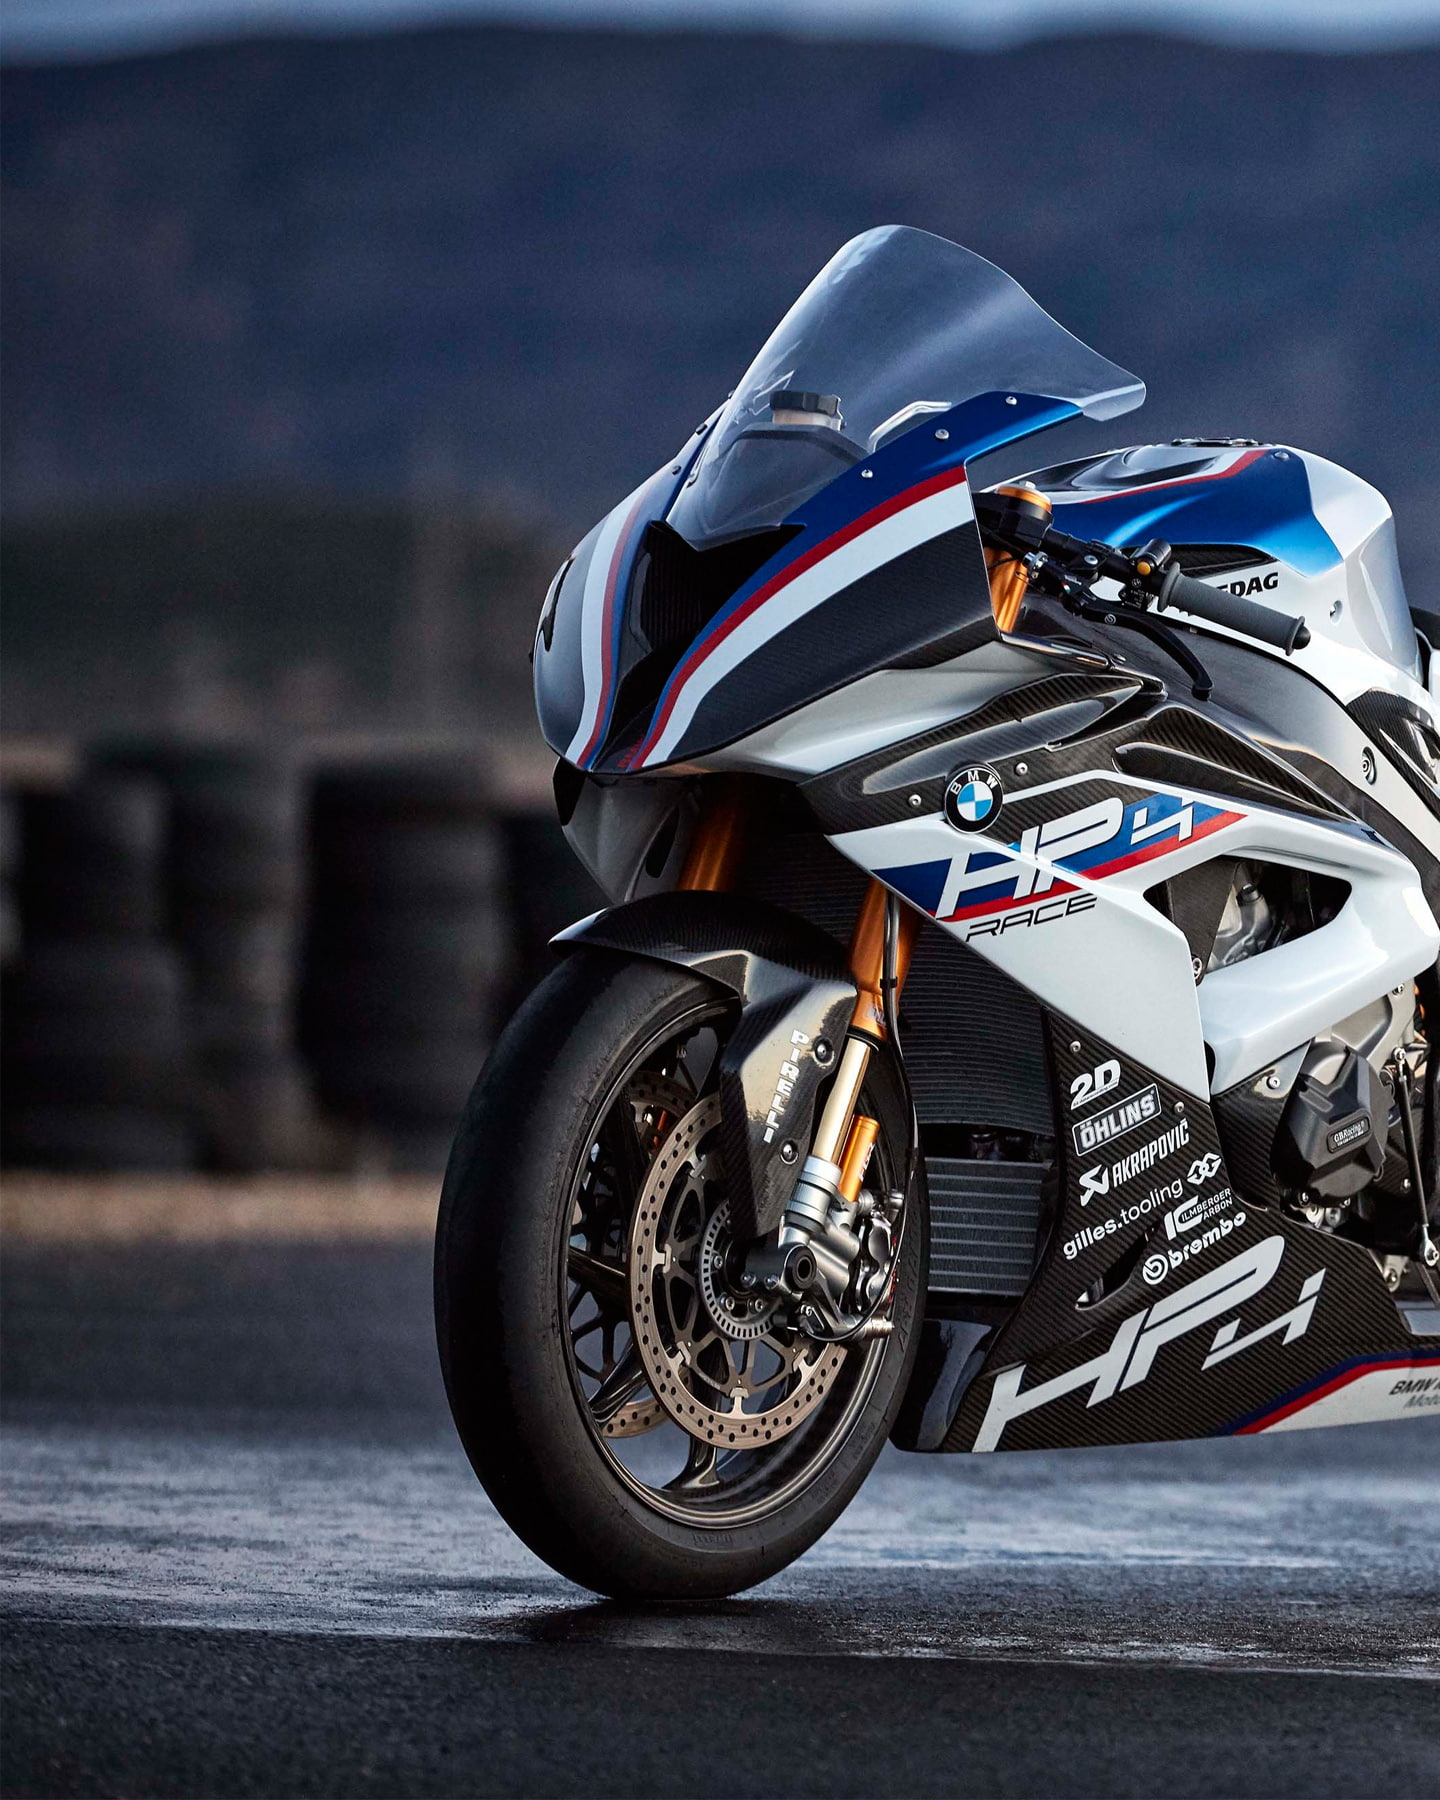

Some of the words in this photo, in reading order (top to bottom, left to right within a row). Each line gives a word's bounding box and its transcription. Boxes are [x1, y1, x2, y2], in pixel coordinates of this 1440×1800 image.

[1216, 571, 1279, 598] DAG
[950, 769, 999, 795] BMW
[936, 797, 1195, 920] HP4
[966, 895, 1099, 943] RACE
[763, 1029, 810, 1144] PIRELLI
[1070, 1059, 1121, 1111] 2D
[1079, 1092, 1156, 1149] ÖHLINS
[1063, 1179, 1183, 1260] gilles.tooling
[1181, 1187, 1232, 1222] ILMBERGER
[1167, 1211, 1247, 1269] brembo
[972, 1235, 1326, 1453] HP4
[1388, 1377, 1439, 1396] BMW
